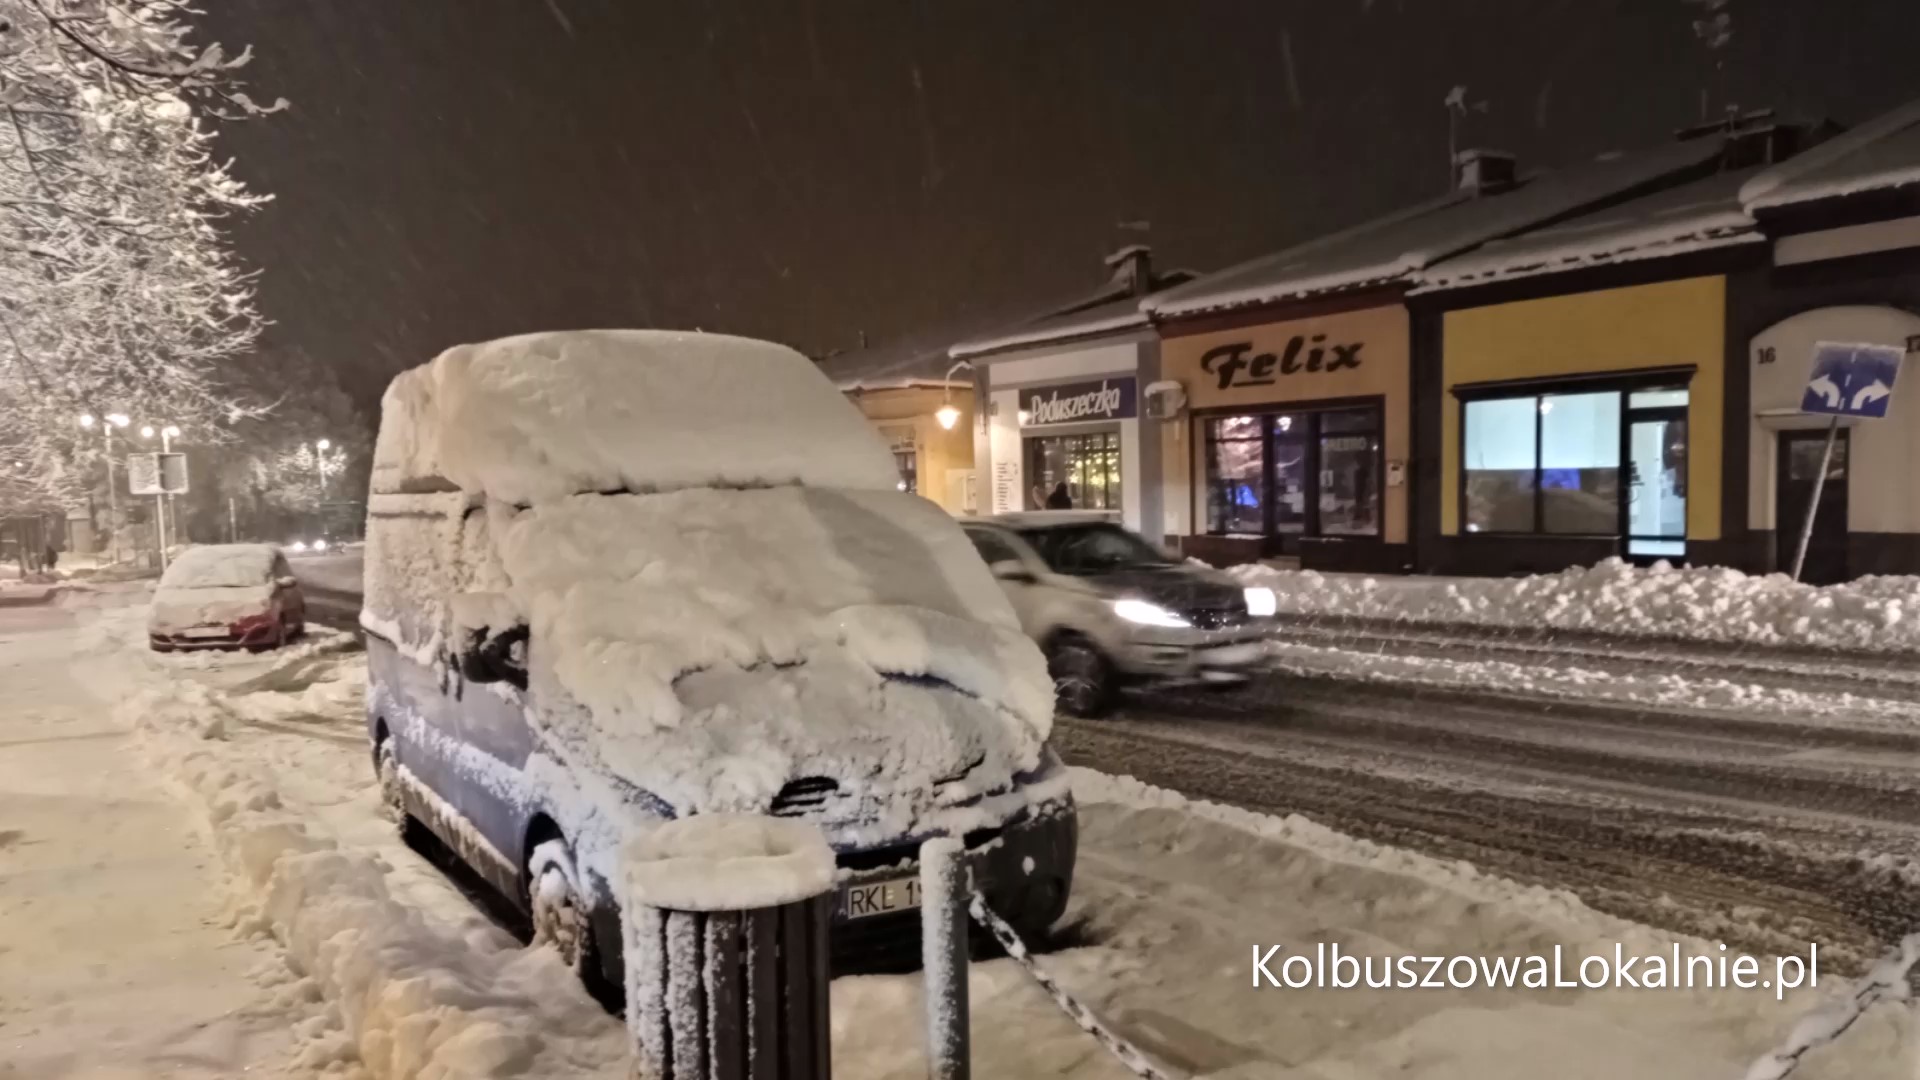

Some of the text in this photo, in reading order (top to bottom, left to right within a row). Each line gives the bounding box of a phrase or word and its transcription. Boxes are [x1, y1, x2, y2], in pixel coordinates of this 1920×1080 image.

[1201, 335, 1364, 390] Felix
[1758, 347, 1776, 364] 16
[1031, 380, 1121, 424] Poduszeczka
[850, 880, 922, 915] RKL 1
